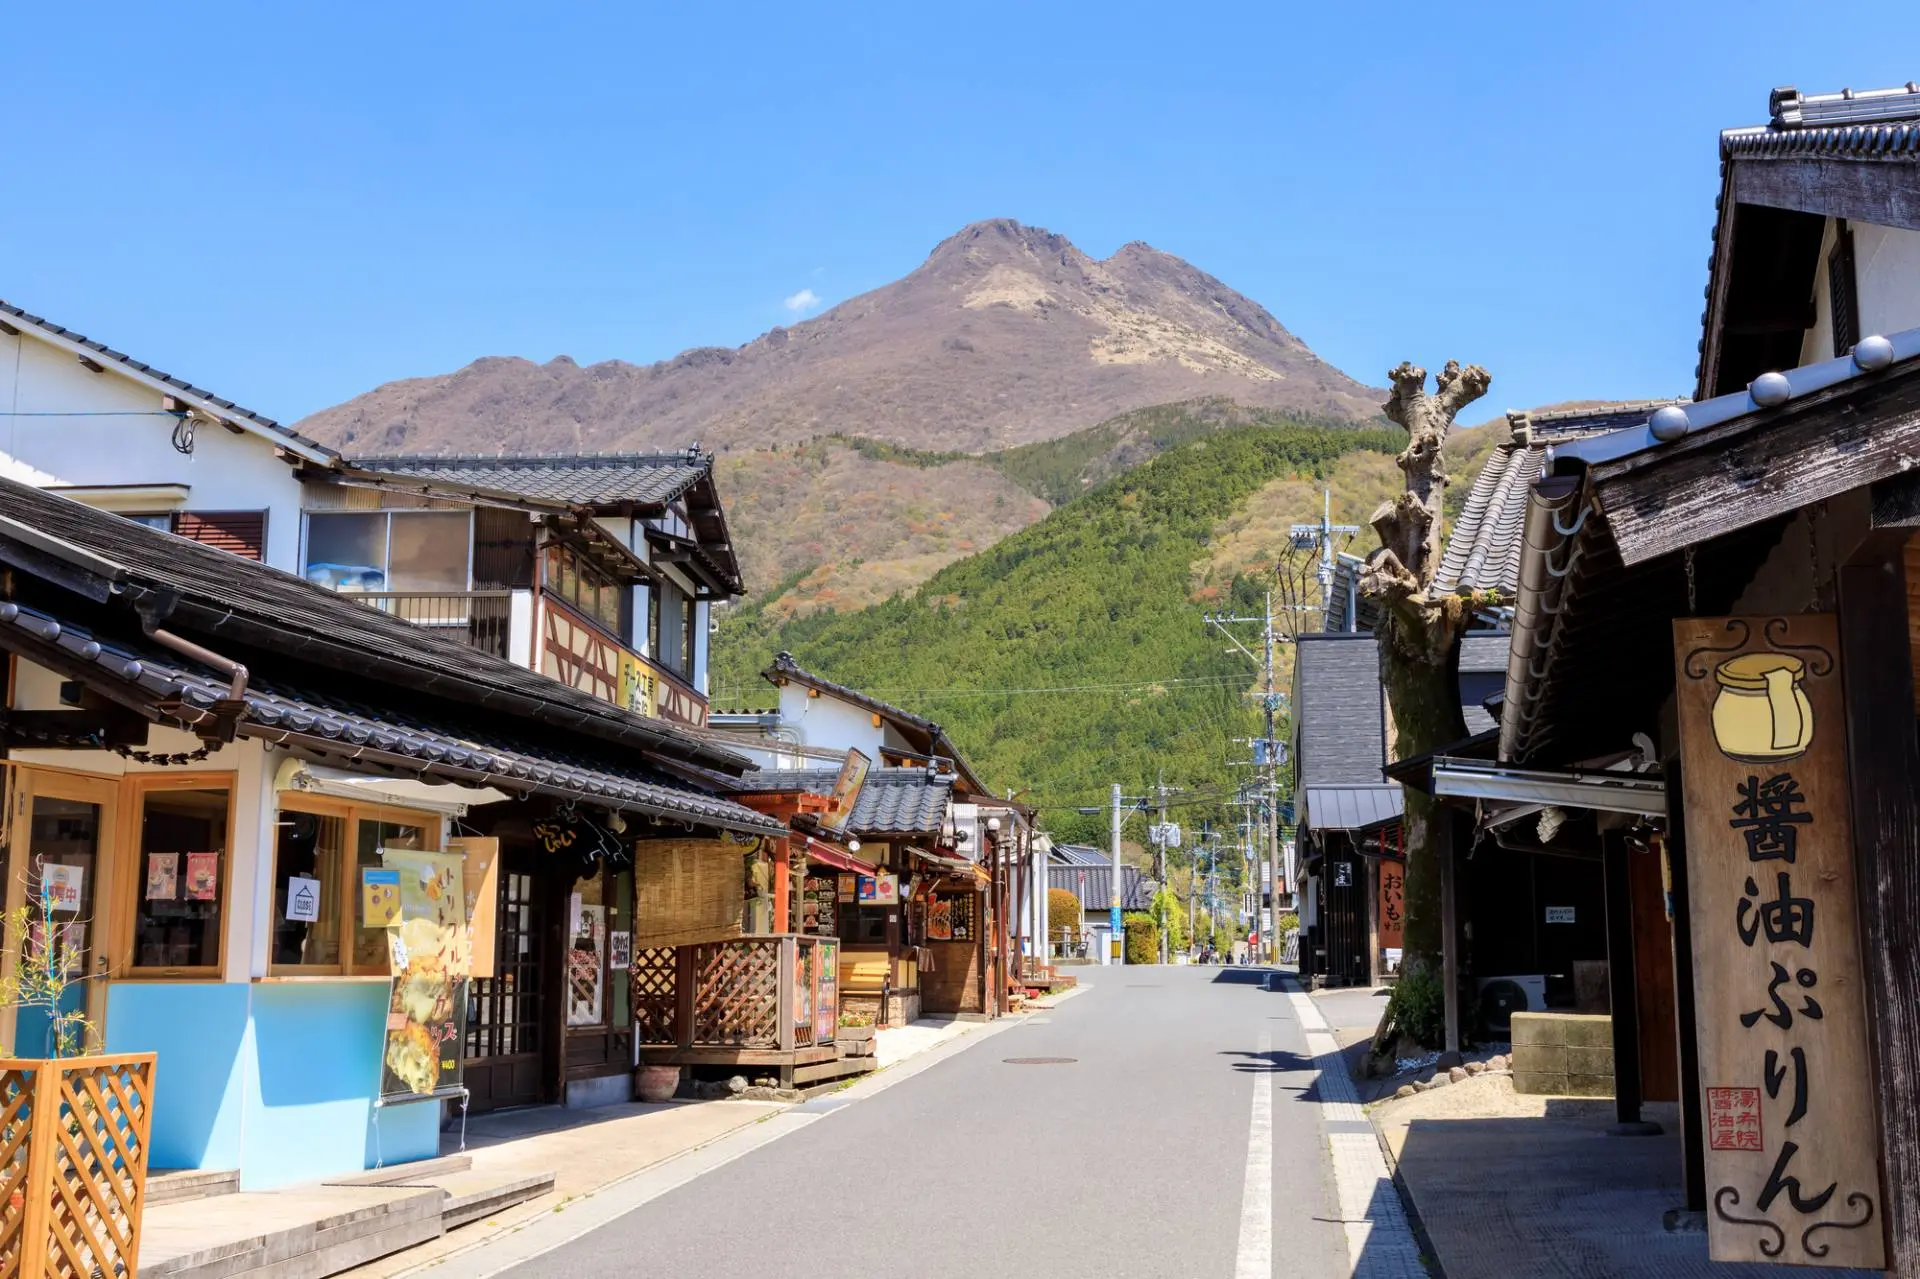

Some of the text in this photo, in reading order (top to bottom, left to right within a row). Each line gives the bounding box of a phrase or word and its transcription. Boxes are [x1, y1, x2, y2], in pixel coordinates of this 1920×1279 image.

[1384, 872, 1402, 920] おいも
[1729, 772, 1838, 1214] 醤油ぷりん
